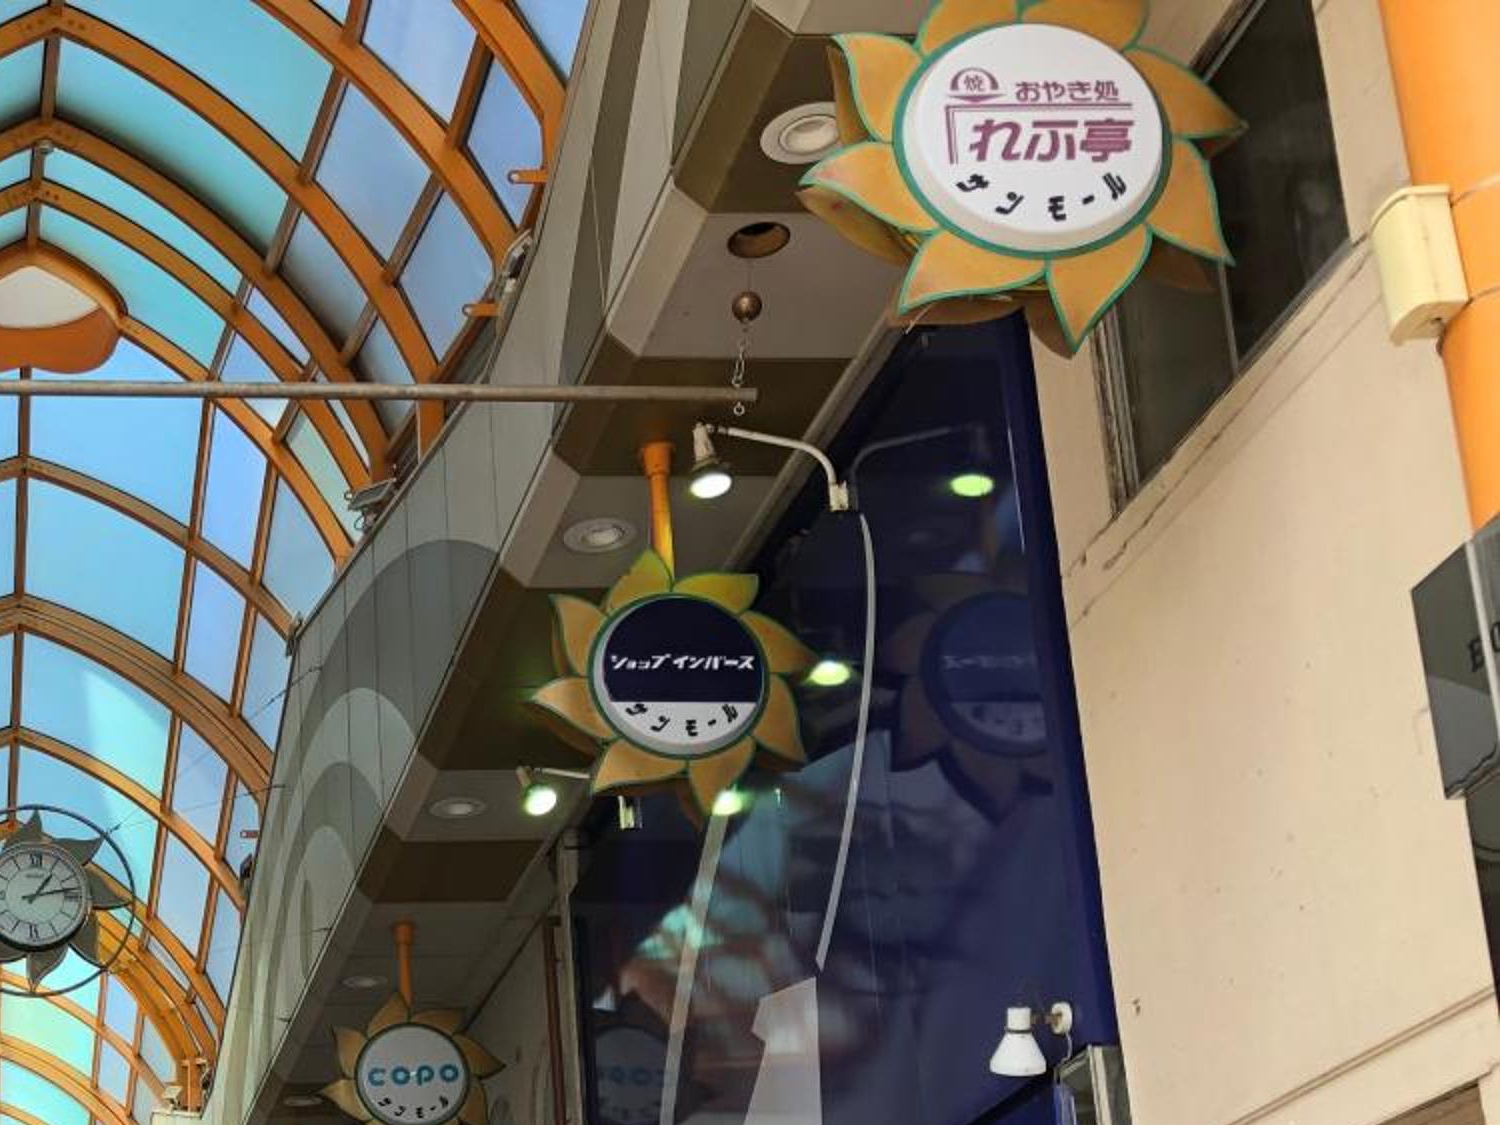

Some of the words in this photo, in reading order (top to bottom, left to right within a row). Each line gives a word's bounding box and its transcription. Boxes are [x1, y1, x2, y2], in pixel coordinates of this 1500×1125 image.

[1014, 79, 1121, 104] おやき処
[955, 171, 1129, 221] サンモール
[610, 653, 756, 672] ショップインバース
[625, 703, 740, 736] サンモール
